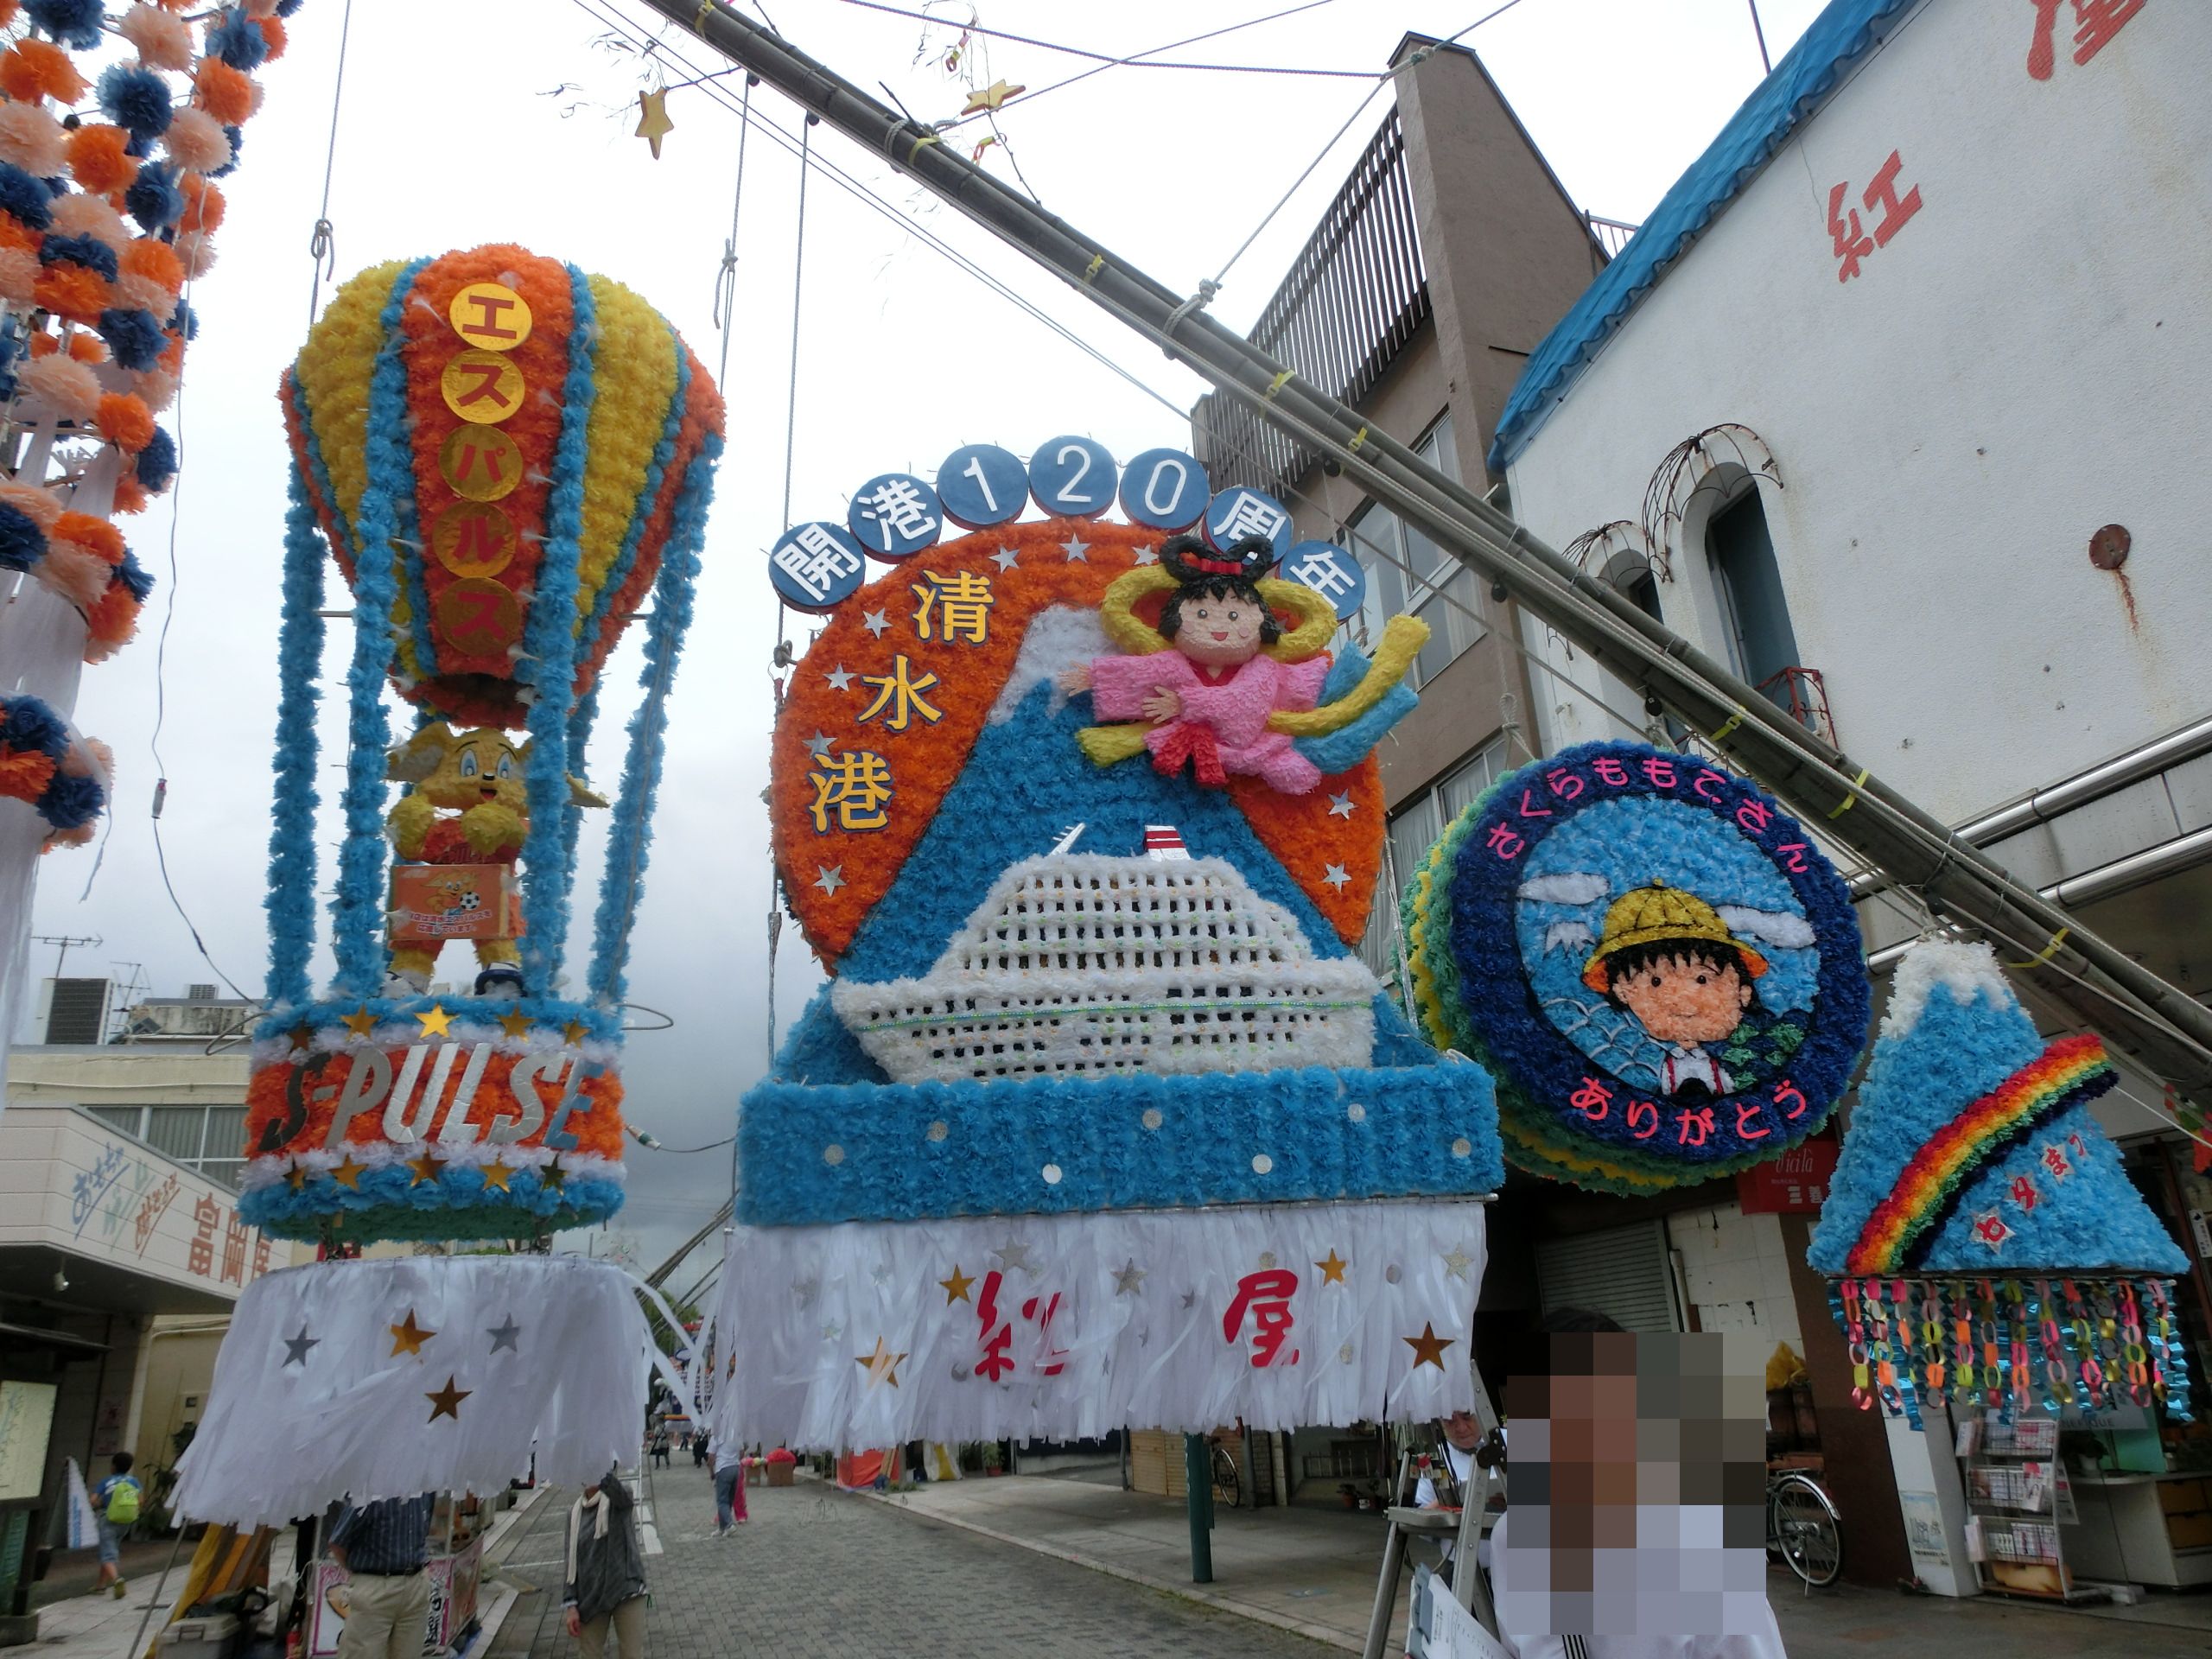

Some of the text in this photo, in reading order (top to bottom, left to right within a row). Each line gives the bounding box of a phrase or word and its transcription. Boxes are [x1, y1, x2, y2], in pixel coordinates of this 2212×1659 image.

[1827, 149, 1923, 283] 紅
[450, 293, 518, 642] エスパルス
[773, 444, 1357, 612] 開港120周年
[809, 569, 995, 834] 清水港
[1486, 756, 1809, 874] さくらももこさん
[259, 1041, 605, 1152] S-PULSE
[1569, 1076, 1807, 1146] ありがとう
